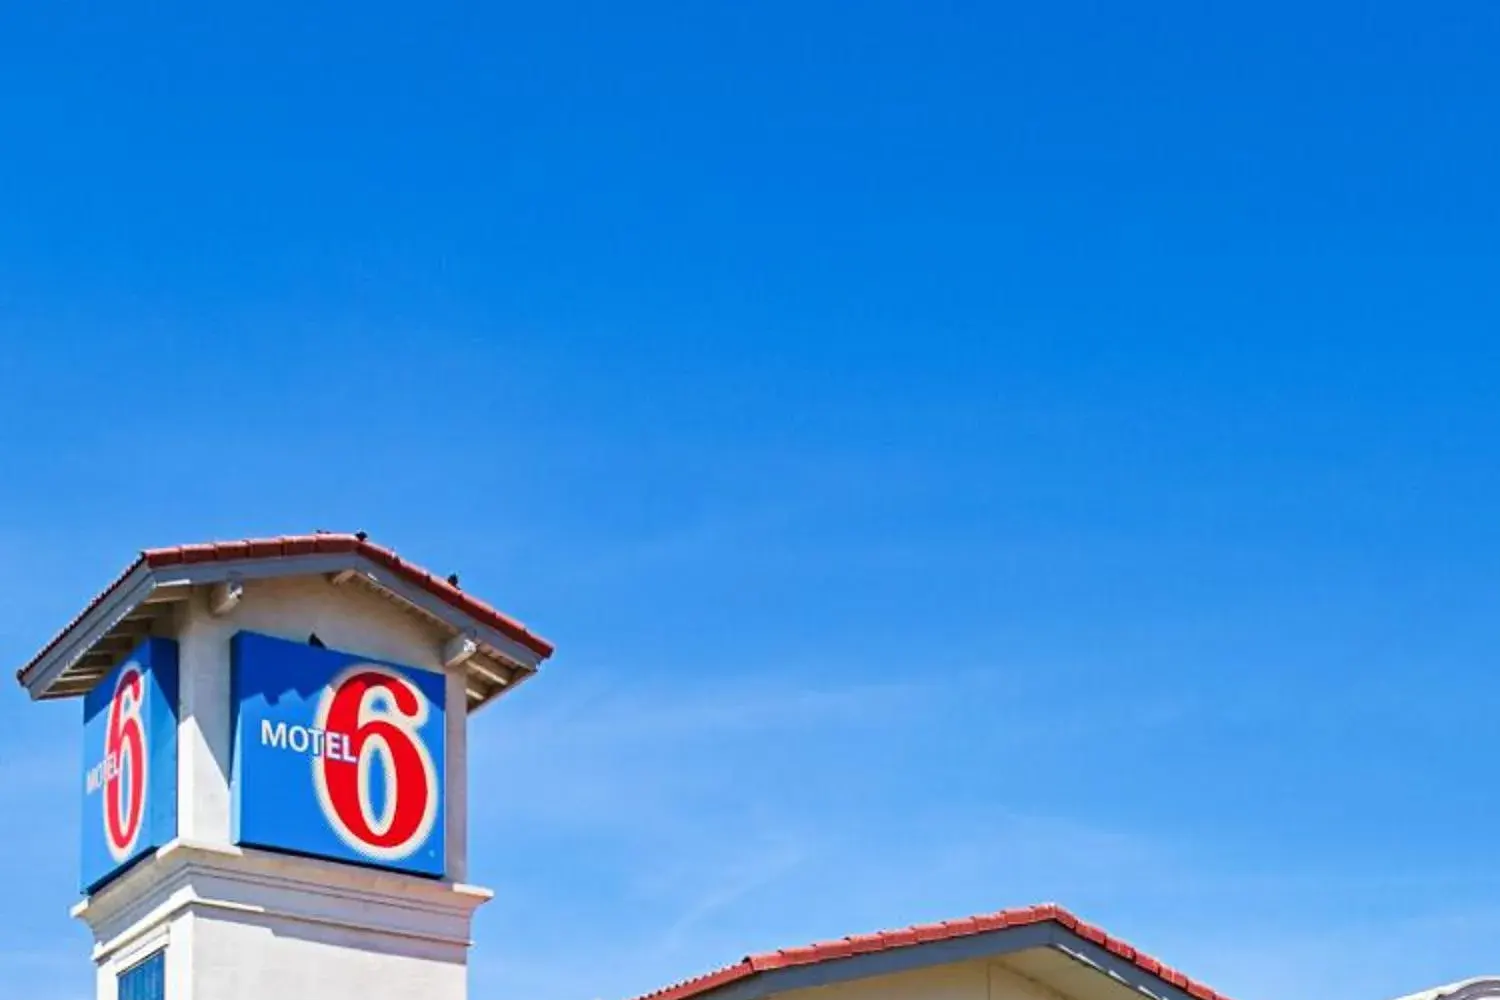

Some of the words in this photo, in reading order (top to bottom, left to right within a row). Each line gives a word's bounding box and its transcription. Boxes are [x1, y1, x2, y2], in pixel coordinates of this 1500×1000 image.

[105, 664, 145, 856] 6
[261, 719, 357, 763] MOTEL
[317, 666, 435, 854] 6
